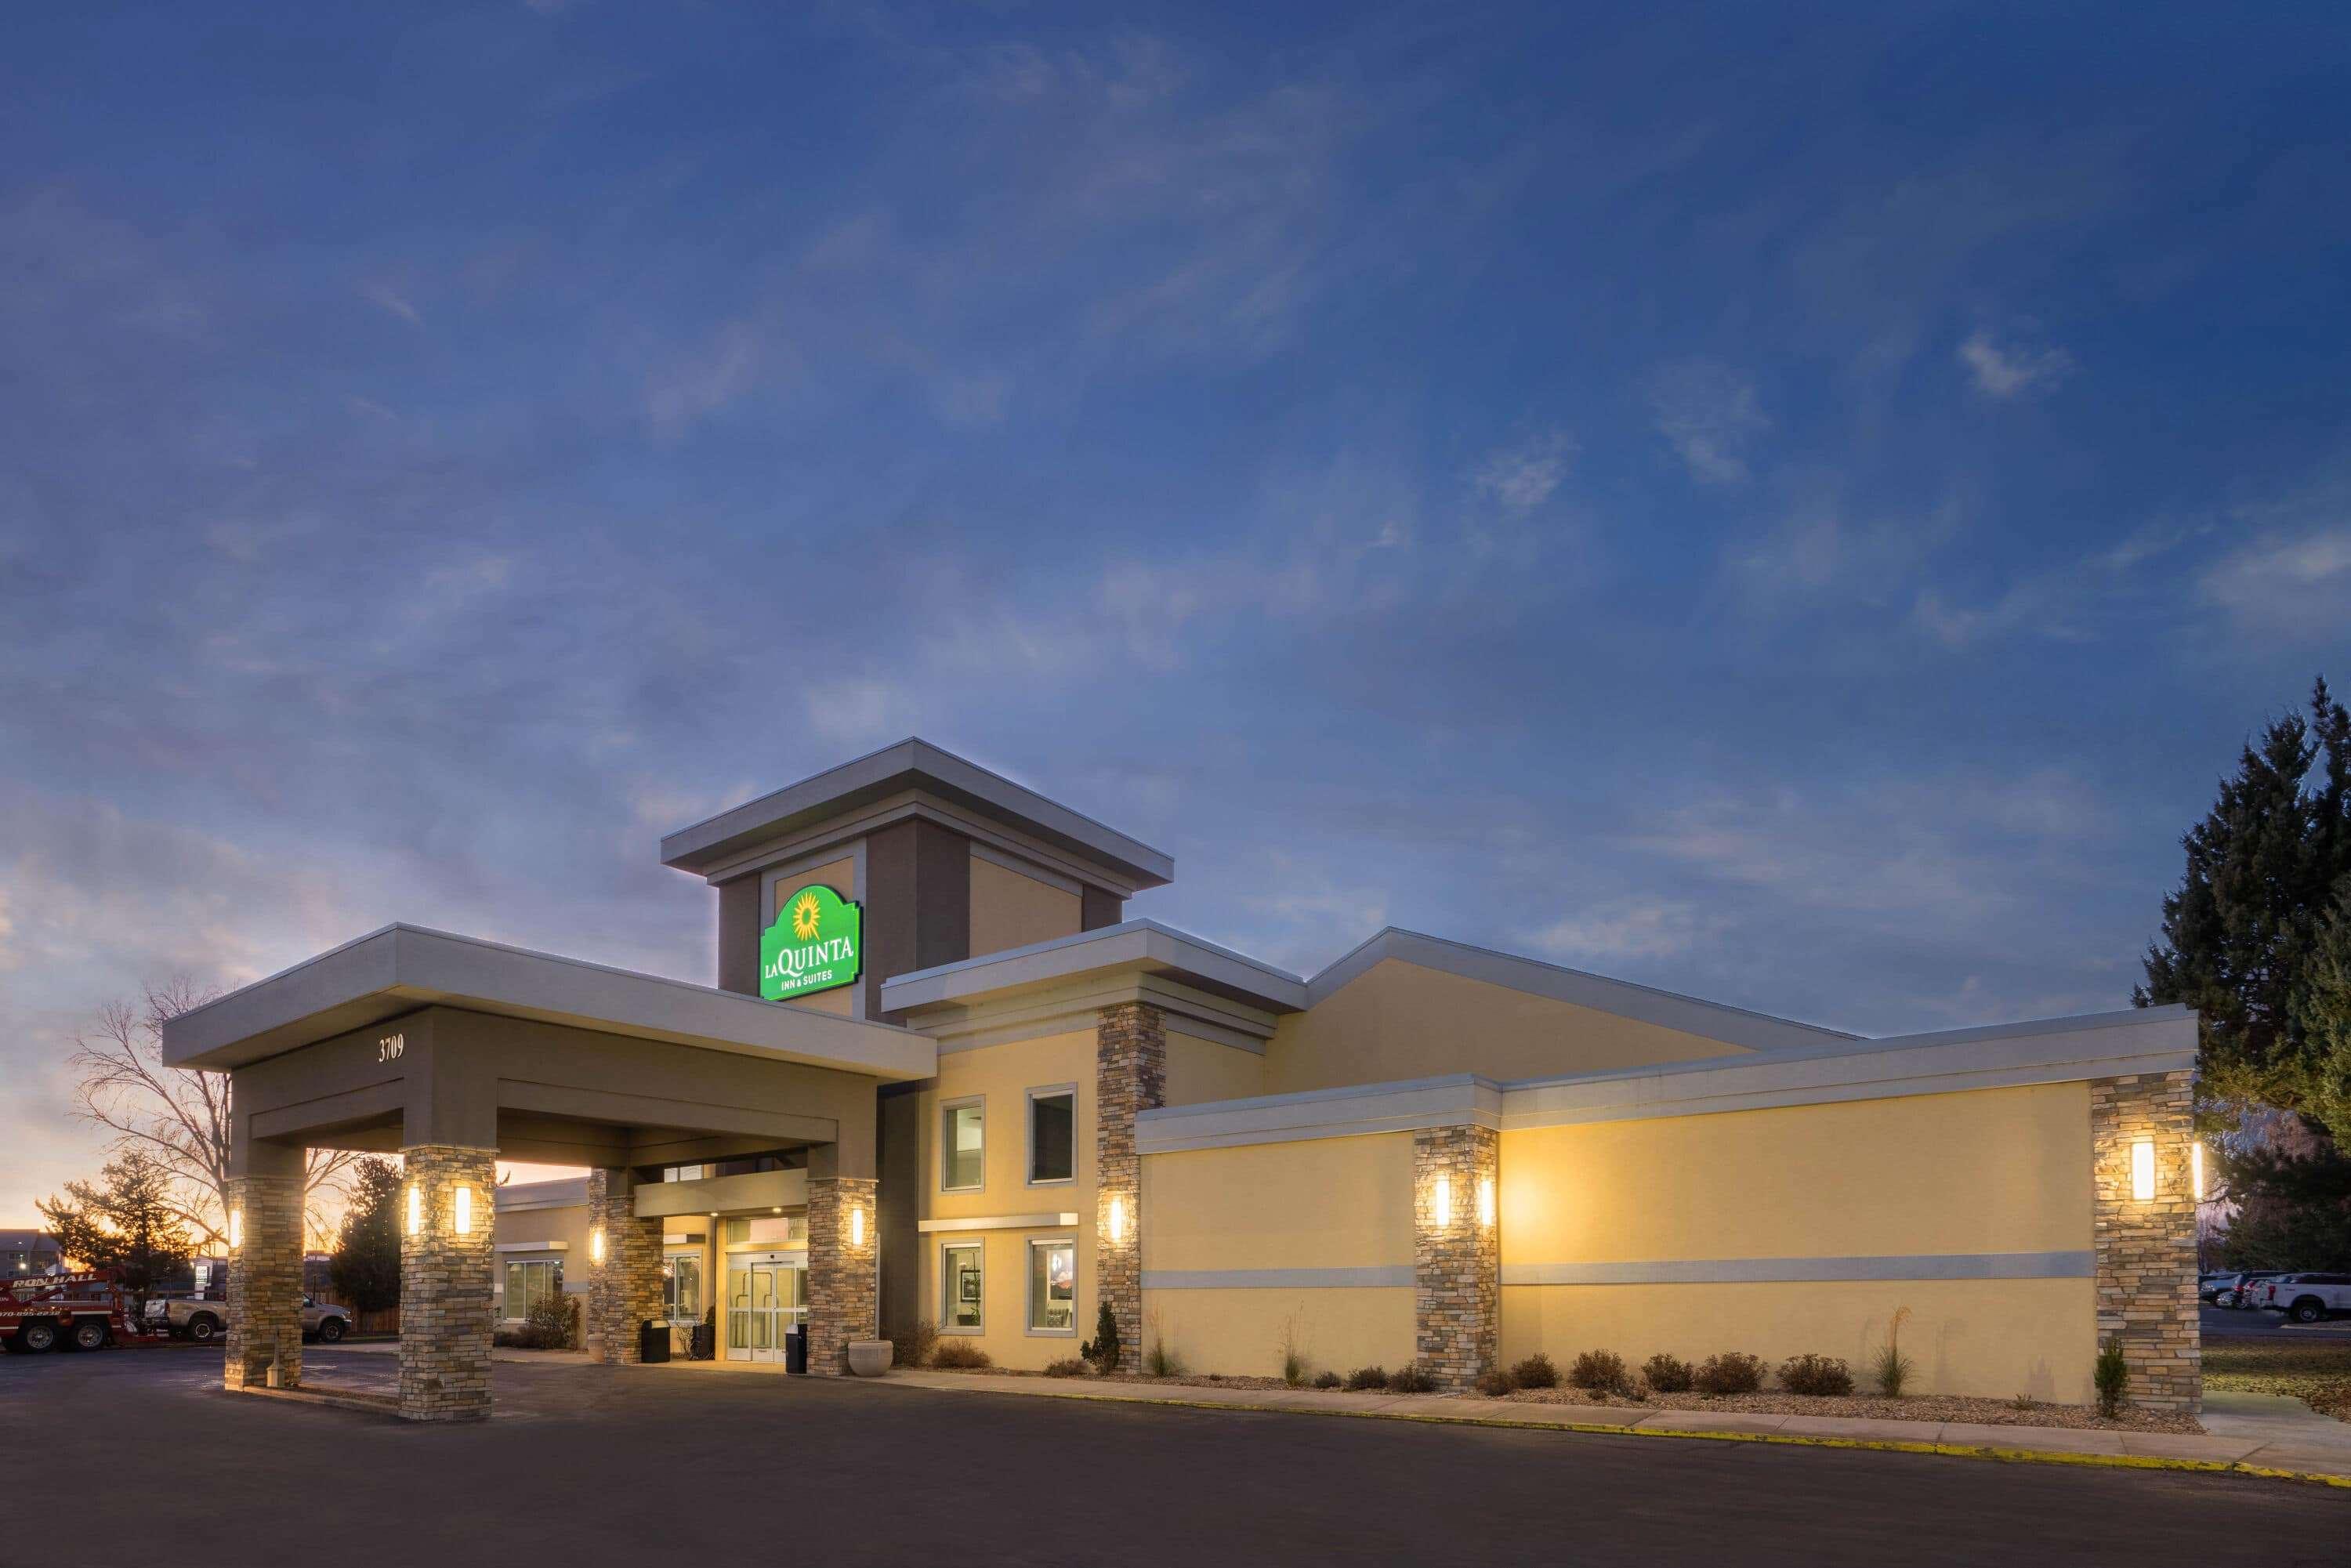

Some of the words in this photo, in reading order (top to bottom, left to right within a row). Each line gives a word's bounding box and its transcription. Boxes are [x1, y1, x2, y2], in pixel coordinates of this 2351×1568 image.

[765, 963, 778, 979] LA
[777, 936, 854, 978] QUINTA
[781, 979, 795, 991] INN
[797, 979, 802, 987] &
[802, 969, 832, 986] SUITES
[379, 1034, 404, 1063] 3709
[13, 1277, 49, 1287] RON
[53, 1273, 96, 1284] HALL
